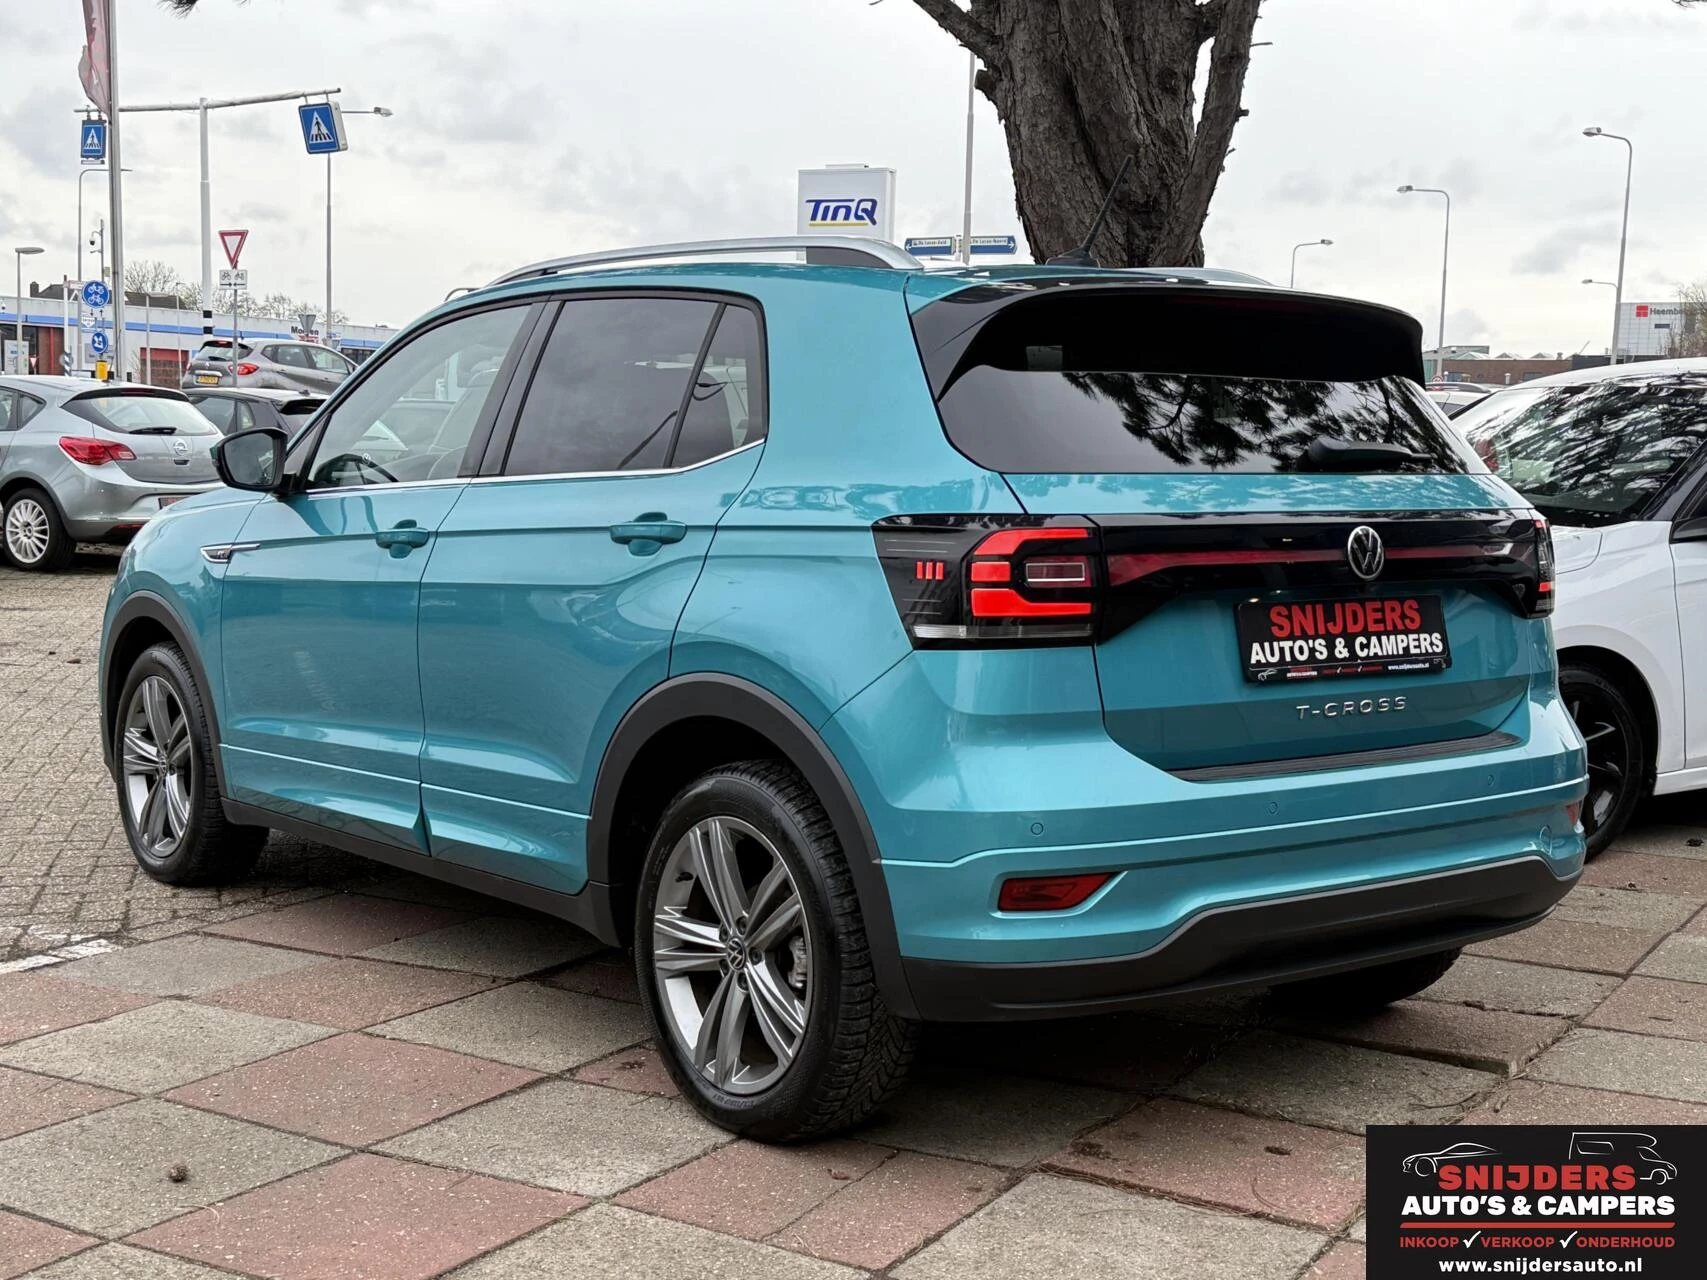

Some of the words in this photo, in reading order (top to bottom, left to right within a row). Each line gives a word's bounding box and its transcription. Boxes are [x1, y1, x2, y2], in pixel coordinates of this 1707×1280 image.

[1269, 600, 1421, 637] SNIJDERS
[1250, 637, 1328, 664] AUTO'S
[1334, 637, 1350, 659] &
[1354, 632, 1443, 658] CAMPERS
[1295, 696, 1407, 720] T-CROSS
